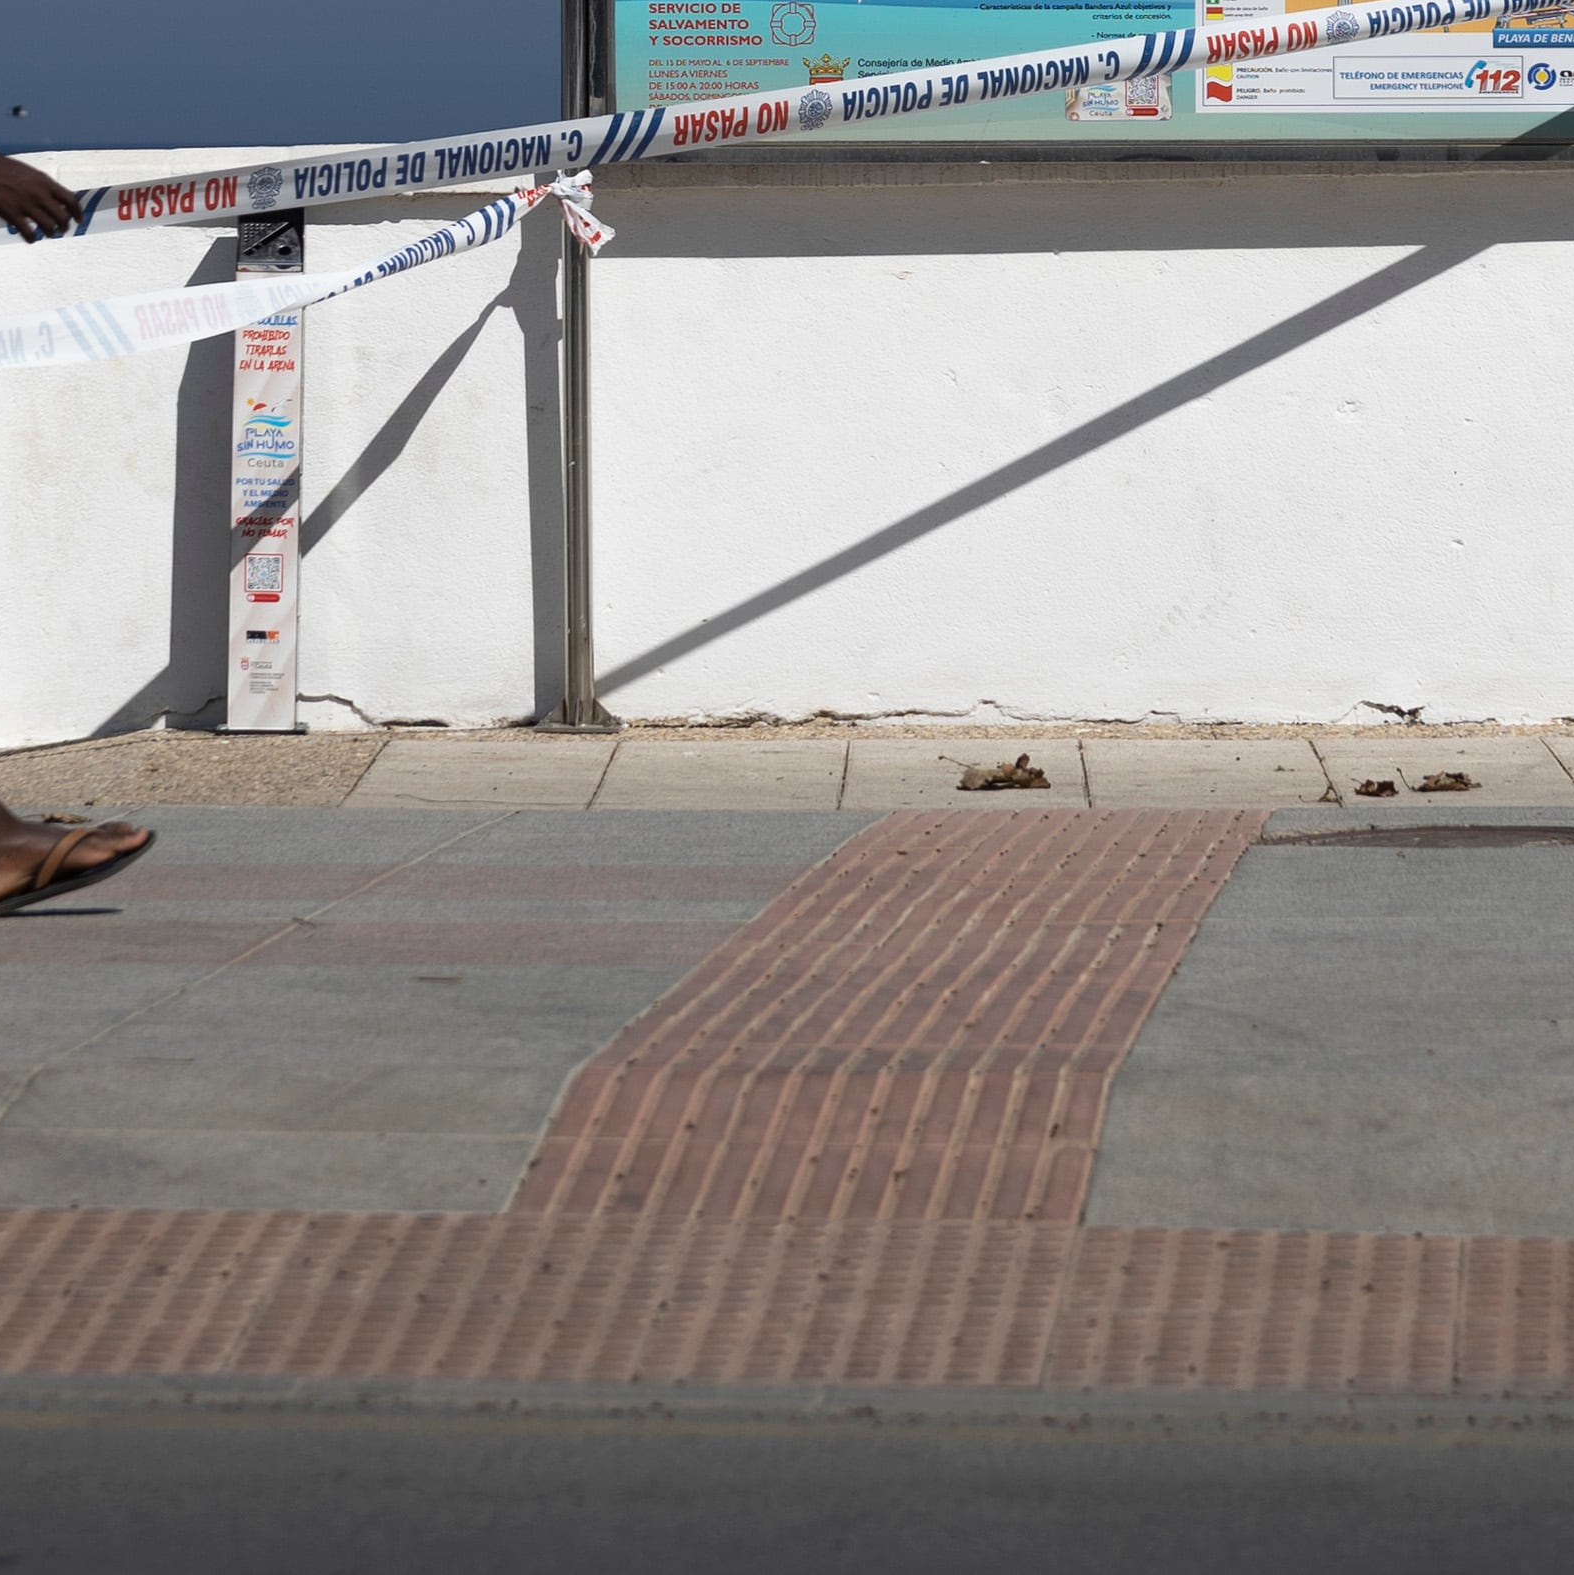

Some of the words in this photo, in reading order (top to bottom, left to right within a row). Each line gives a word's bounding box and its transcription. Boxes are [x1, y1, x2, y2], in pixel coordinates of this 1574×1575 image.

[648, 2, 716, 14] SERVICIO
[721, 2, 740, 14] DE
[648, 18, 748, 30] SALVAMENTO
[649, 35, 658, 46] Y
[662, 35, 762, 46] SOCORRISMO
[1497, 33, 1530, 43] PLAYA
[1532, 32, 1549, 43] DE
[857, 58, 908, 69] Consejería
[910, 58, 923, 67] de
[1097, 50, 1121, 80] C.
[648, 69, 679, 78] LUNES
[680, 69, 688, 78] A
[688, 69, 727, 78] VIERNES
[978, 55, 1090, 99] NACIONAL
[1339, 70, 1385, 80] TELÉFONO
[1386, 71, 1398, 80] DE
[1400, 71, 1463, 80] EMERGENCIAS
[1476, 69, 1519, 90] 112
[648, 81, 662, 90] DE
[665, 81, 688, 90] 15:00
[689, 81, 697, 90] A
[698, 81, 722, 90] 20:00
[724, 80, 759, 90] HORAS
[940, 75, 969, 106] DE
[1369, 82, 1417, 90] EMERGENCY
[1419, 81, 1465, 90] TELEPHONE
[757, 100, 789, 132] NO
[674, 106, 749, 145] PASAR
[560, 130, 583, 160] C.
[435, 135, 551, 179] NACIONAL
[396, 151, 426, 184] DE
[205, 175, 238, 210] NO
[119, 181, 195, 221] PASAR
[242, 329, 290, 342] PROHIBIDO
[245, 428, 284, 441] PLAYA
[237, 439, 254, 452] SIN
[256, 440, 295, 452] HUMO
[247, 457, 284, 468] Ceuta
[236, 478, 252, 486] POR
[255, 478, 265, 486] TU
[266, 478, 295, 486] SALUD
